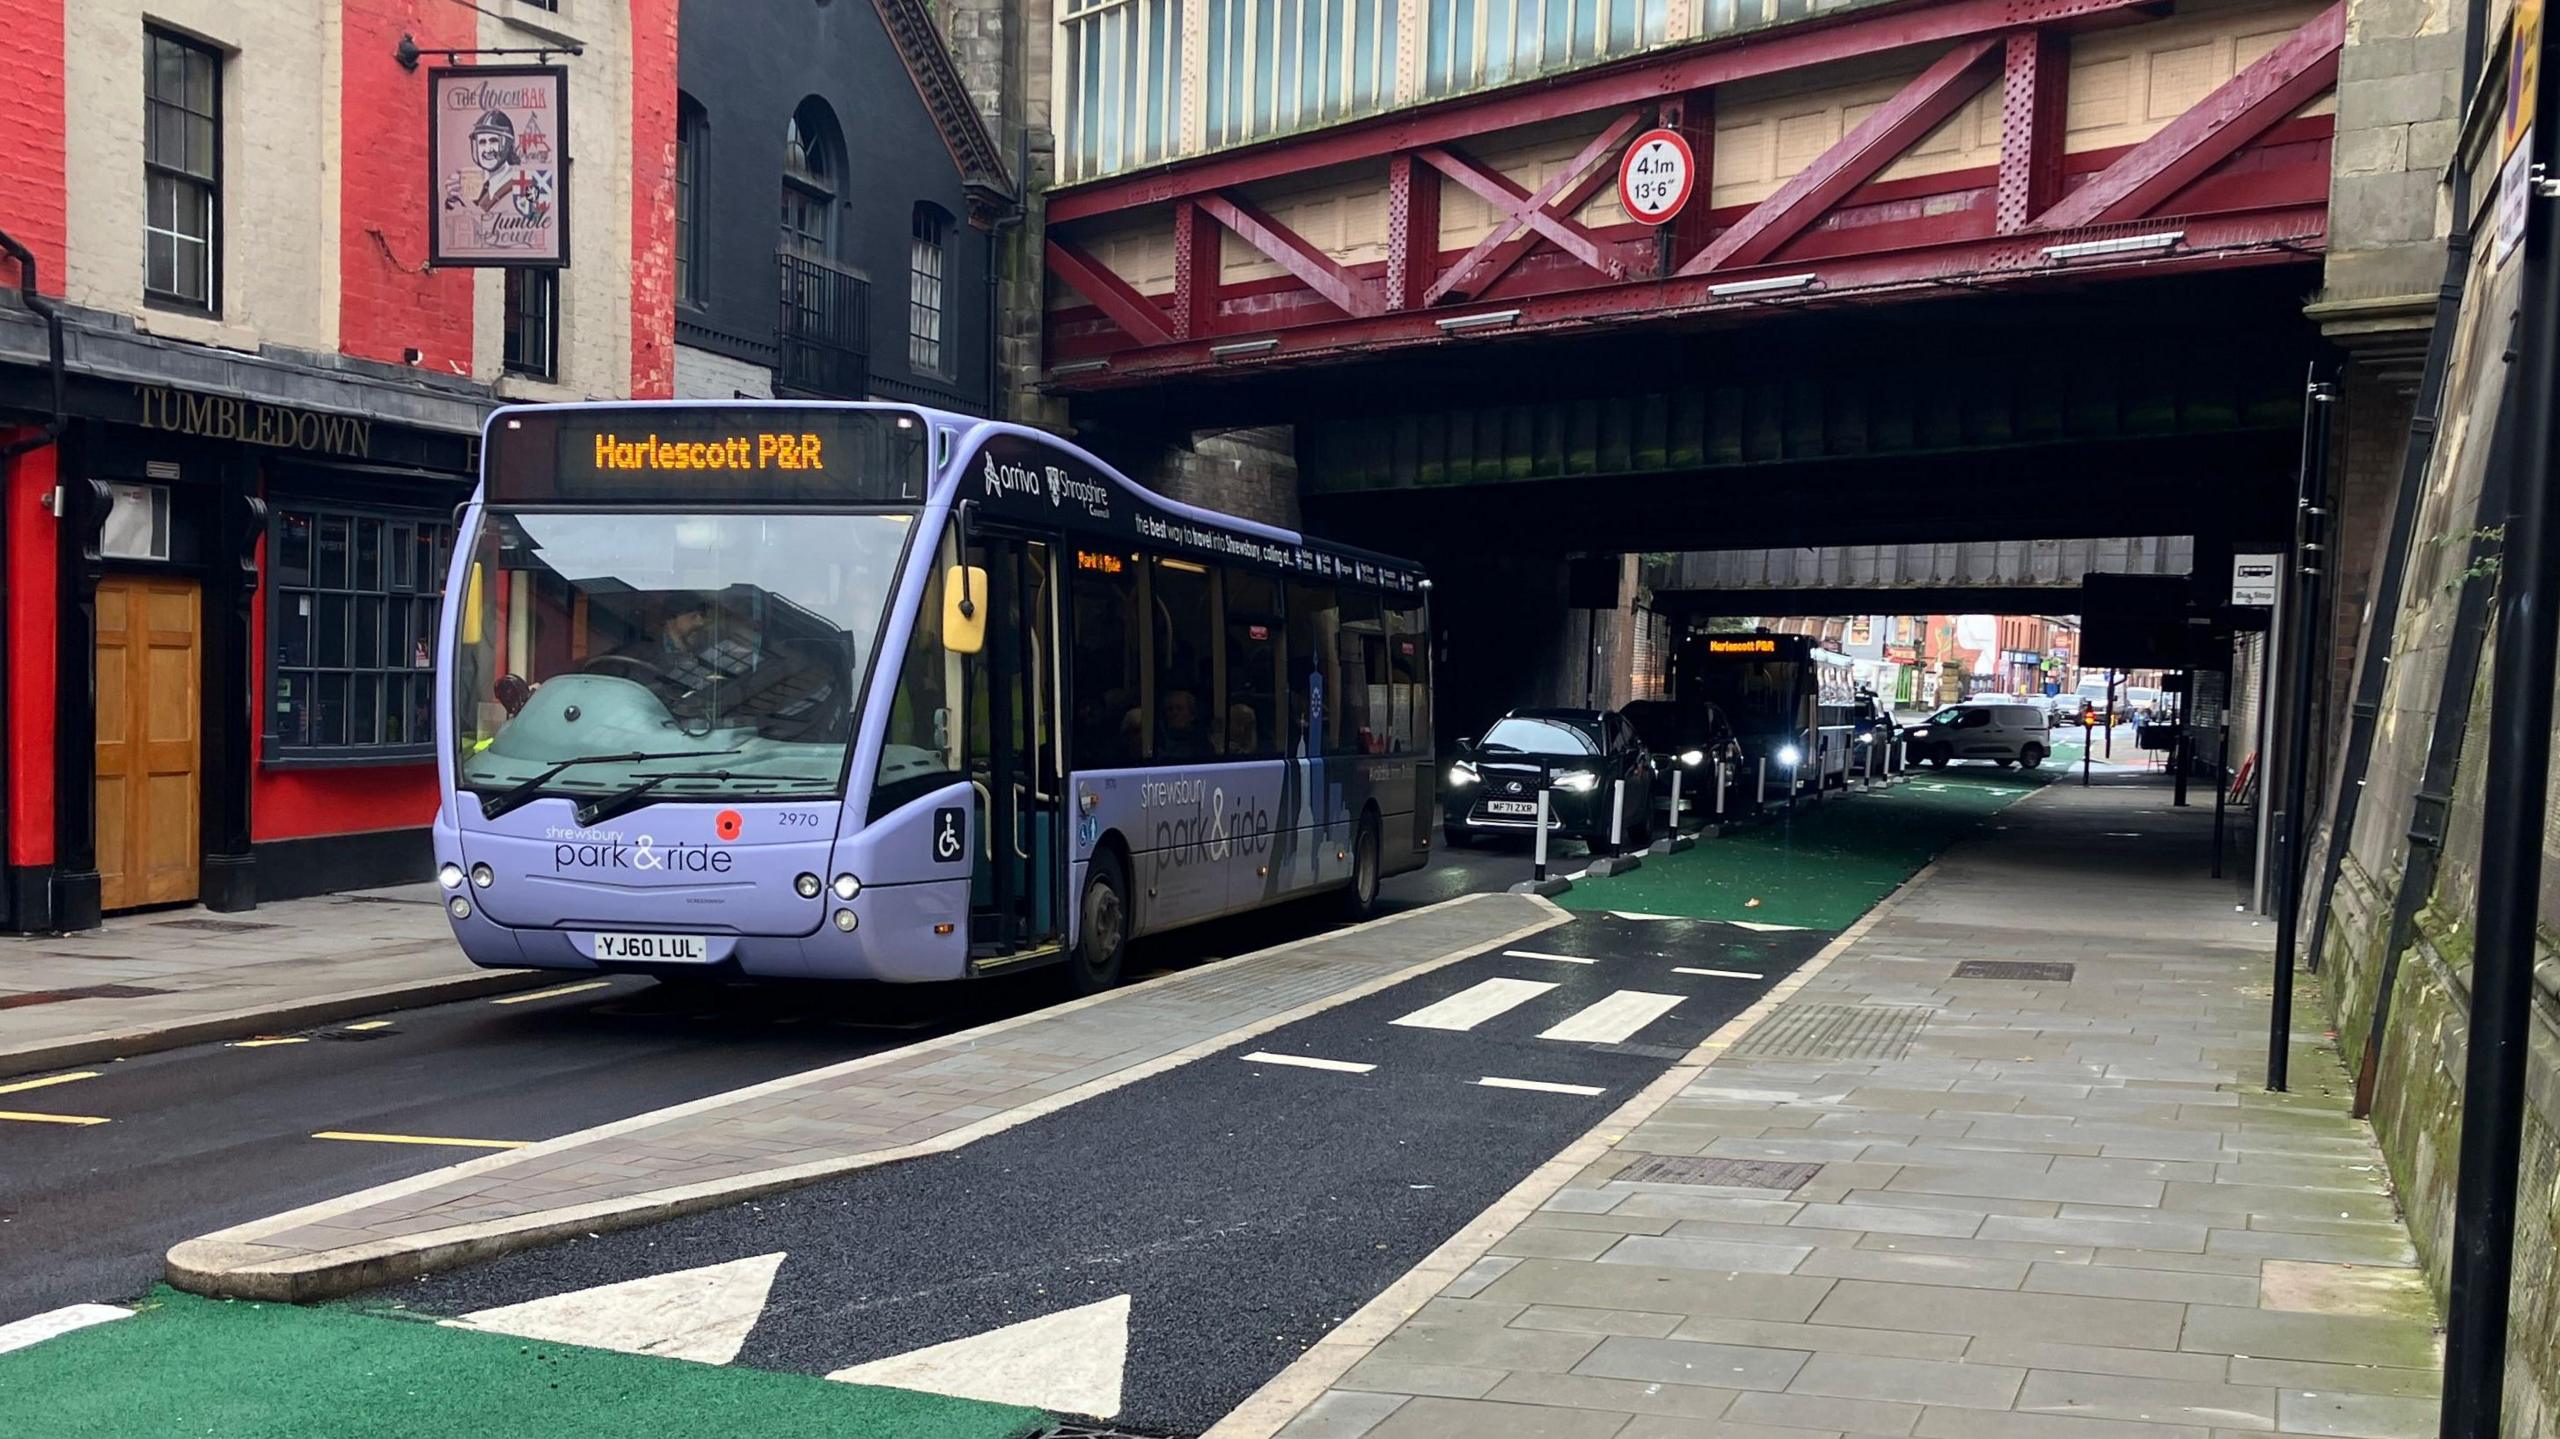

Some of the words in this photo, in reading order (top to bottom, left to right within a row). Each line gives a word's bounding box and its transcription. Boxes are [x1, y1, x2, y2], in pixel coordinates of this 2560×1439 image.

[521, 87, 546, 109] BAR
[1636, 157, 1674, 175] 4.1m
[133, 384, 372, 459] TUMBLEDOWN
[595, 433, 751, 470] Harlescott
[758, 433, 823, 470] P&R
[1000, 462, 1040, 496] arriva
[1060, 470, 1109, 509] Shropshire
[1135, 512, 1149, 535] the
[1150, 516, 1167, 539] best
[1167, 526, 1183, 546] way
[1184, 525, 1192, 544] to
[1193, 527, 1211, 549] travel
[1211, 531, 1225, 551] into
[1263, 544, 1283, 567] calling
[1141, 774, 1206, 810] shrewsbury
[1493, 802, 1513, 812] MF71
[1515, 803, 1533, 812] ZXR
[545, 826, 624, 843] shrewsbury
[778, 812, 819, 827] 2970
[1155, 802, 1208, 887] park
[1210, 787, 1230, 861] &
[1230, 796, 1268, 859] ride
[556, 841, 629, 872] park
[633, 834, 663, 871] &
[667, 841, 732, 872] ride
[602, 936, 652, 958] YJ60
[659, 938, 697, 958] LUL
